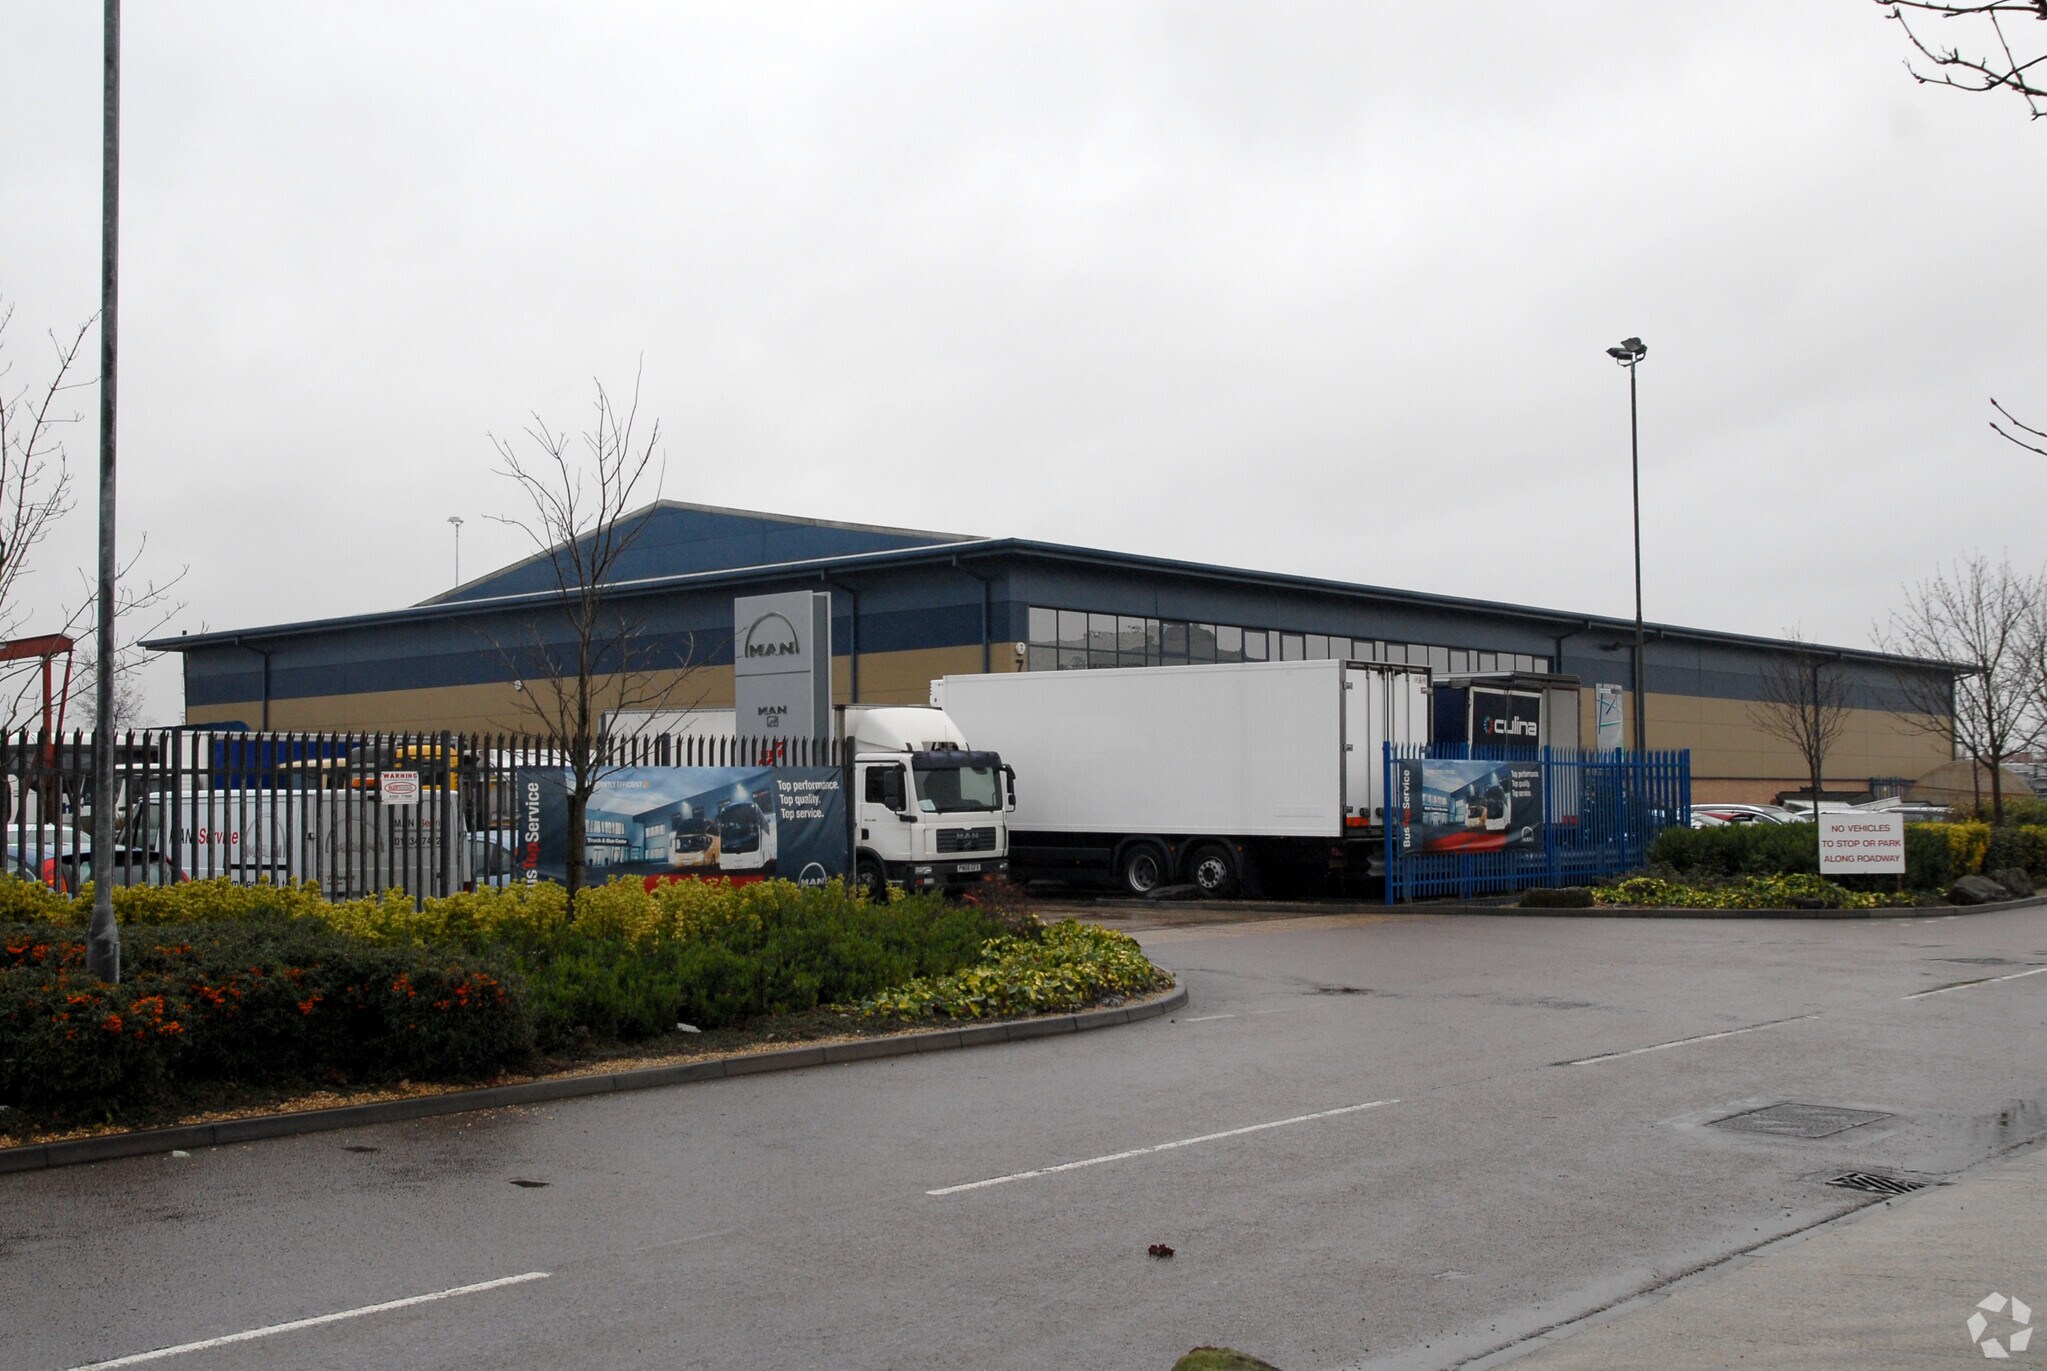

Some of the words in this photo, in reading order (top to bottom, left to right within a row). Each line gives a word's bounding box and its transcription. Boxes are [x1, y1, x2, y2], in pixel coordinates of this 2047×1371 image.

[750, 641, 795, 657] MAN
[1015, 659, 1024, 672] 7
[758, 705, 787, 715] MAN
[1494, 716, 1537, 736] culina
[777, 780, 792, 792] Top
[793, 780, 839, 792] performance.
[779, 794, 794, 806] Top
[795, 794, 821, 806] quality.
[781, 808, 795, 820] Top
[796, 807, 824, 819] service.
[1847, 824, 1890, 832] VEHICLES
[522, 782, 540, 888] usTopService
[1857, 854, 1900, 862] ROADWAY
[801, 878, 825, 886] MAN
